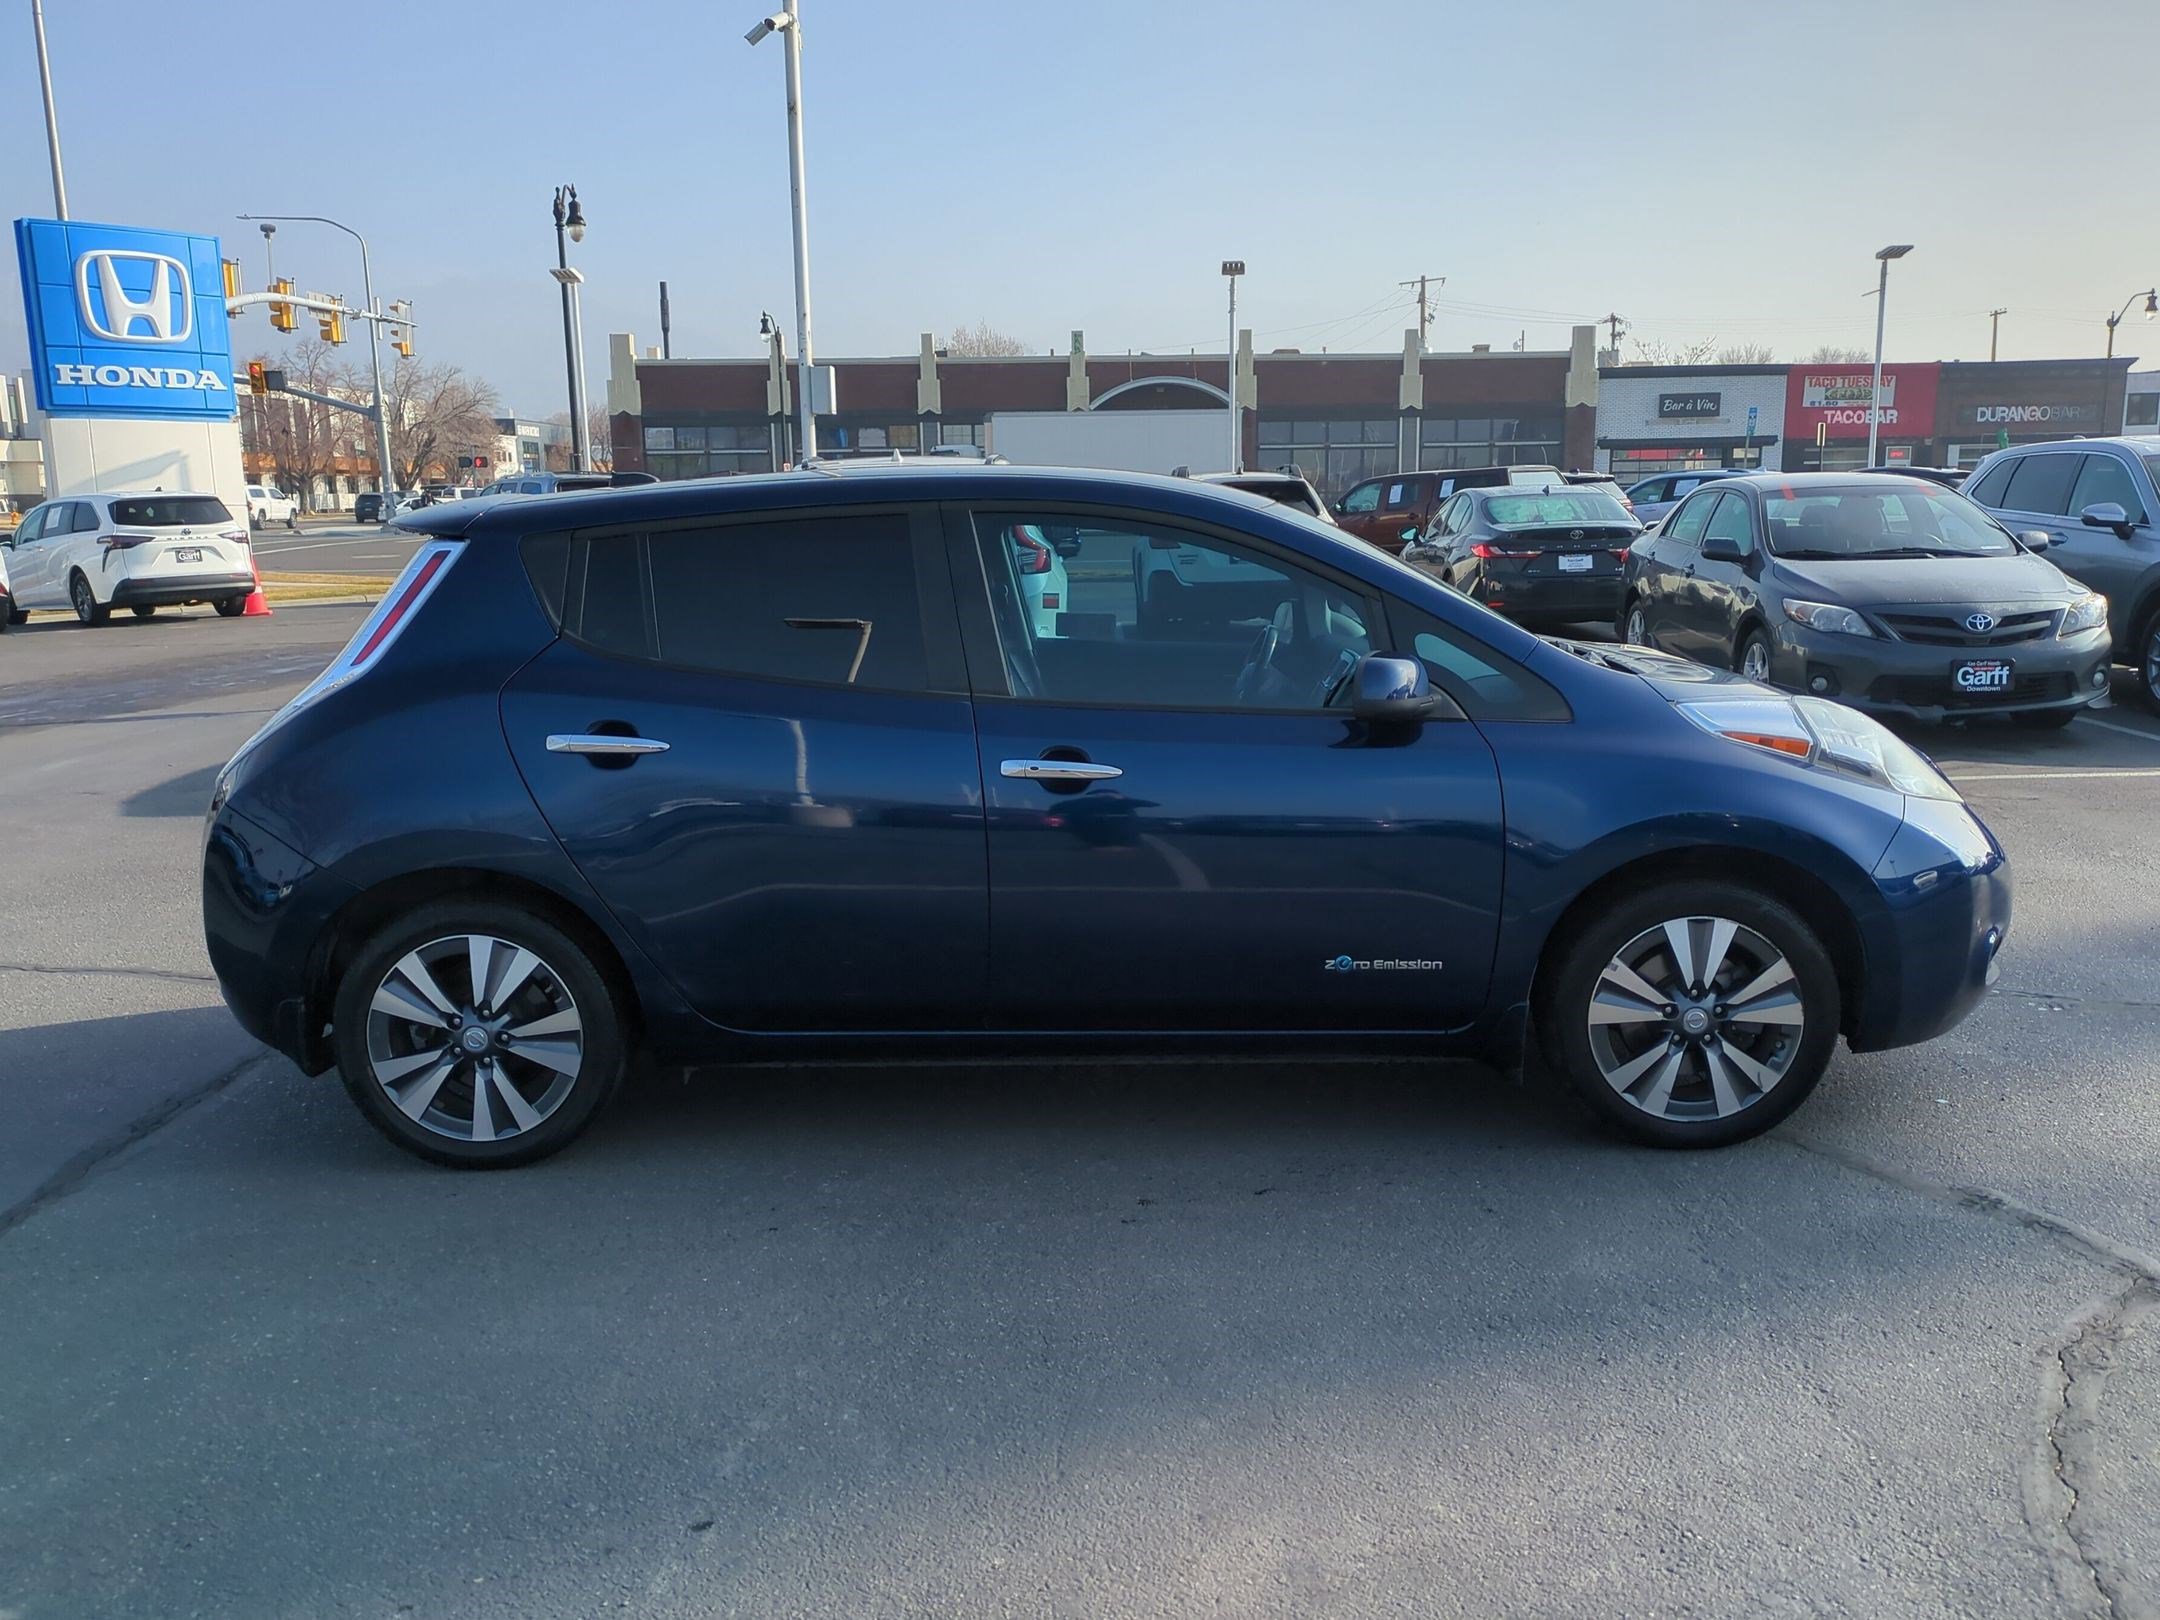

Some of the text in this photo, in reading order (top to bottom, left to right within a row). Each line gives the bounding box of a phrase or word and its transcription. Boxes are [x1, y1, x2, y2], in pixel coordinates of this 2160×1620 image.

[54, 364, 228, 391] HONDA
[1808, 375, 1894, 388] TACO TUESAY
[1663, 399, 1717, 411] Bar à Vin
[1957, 666, 2010, 686] Garff
[1373, 959, 1443, 970] Emission
